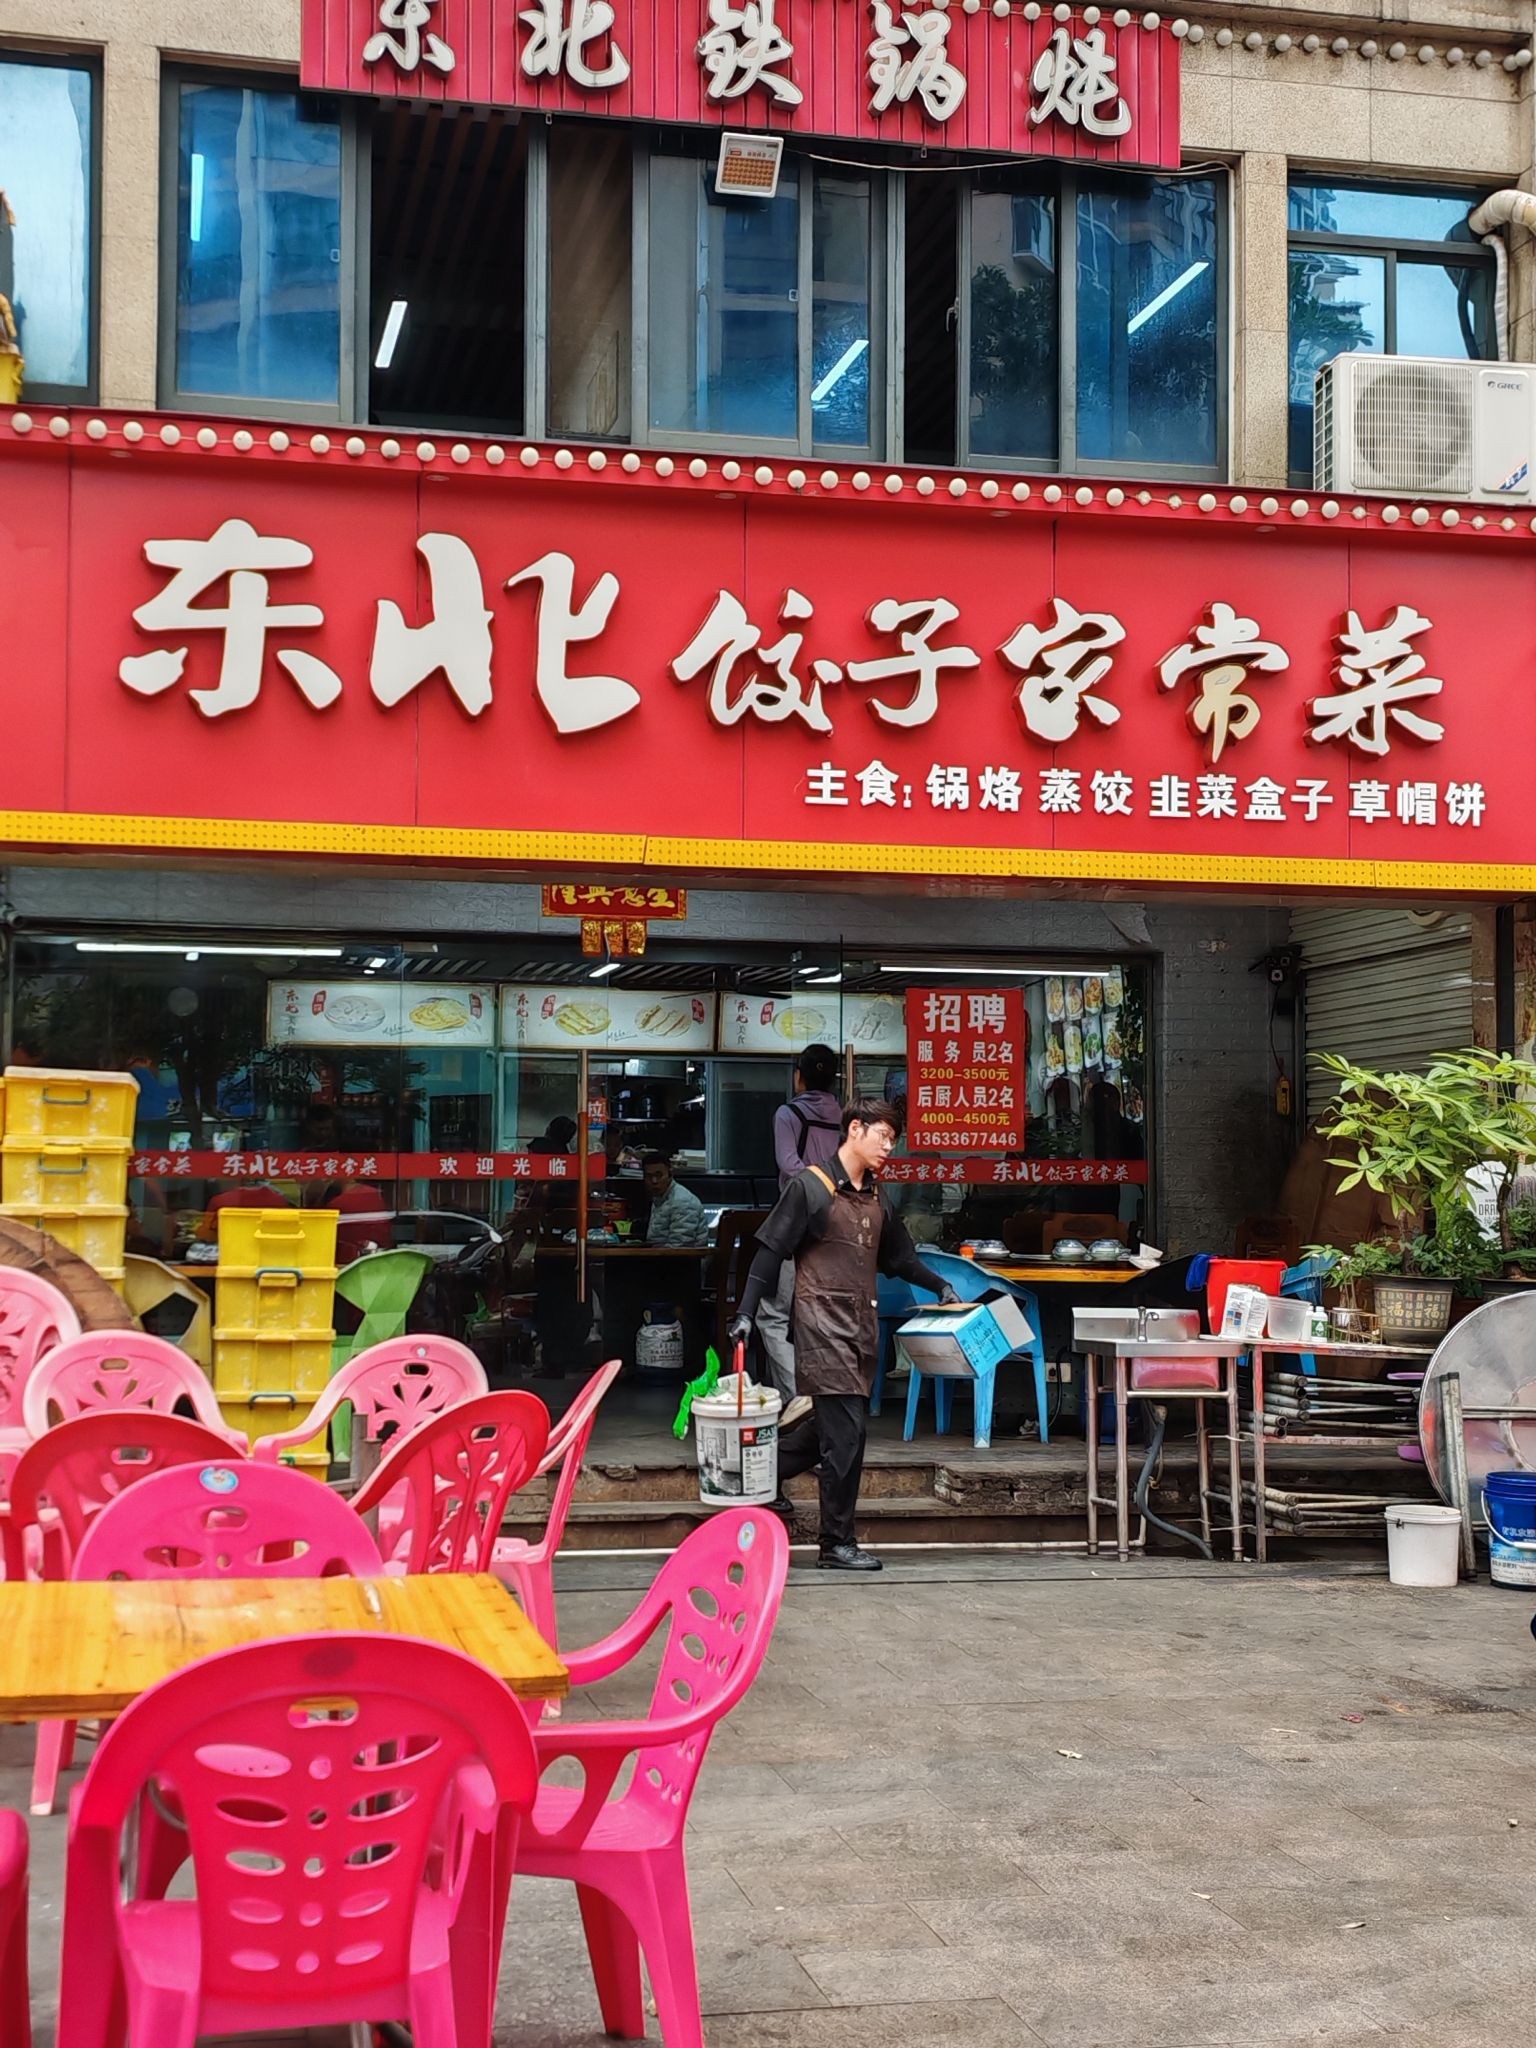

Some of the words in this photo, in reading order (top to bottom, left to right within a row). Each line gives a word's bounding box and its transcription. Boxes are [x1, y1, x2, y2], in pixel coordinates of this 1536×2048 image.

[117, 518, 1445, 763] 东北饺子家常菜
[1038, 768, 1133, 817] 蒸饺
[1149, 774, 1334, 823] 韭菜盒子
[1348, 780, 1487, 828] 草帽饼
[923, 992, 1007, 1034] 招聘
[917, 1085, 1014, 1109] 后厨人员2名
[914, 1132, 1017, 1146] 13633677446
[222, 1154, 378, 1177] 东北饺子家常菜
[439, 1156, 567, 1176] 欢迎光临
[992, 1162, 1129, 1182] 东北饺子家常菜
